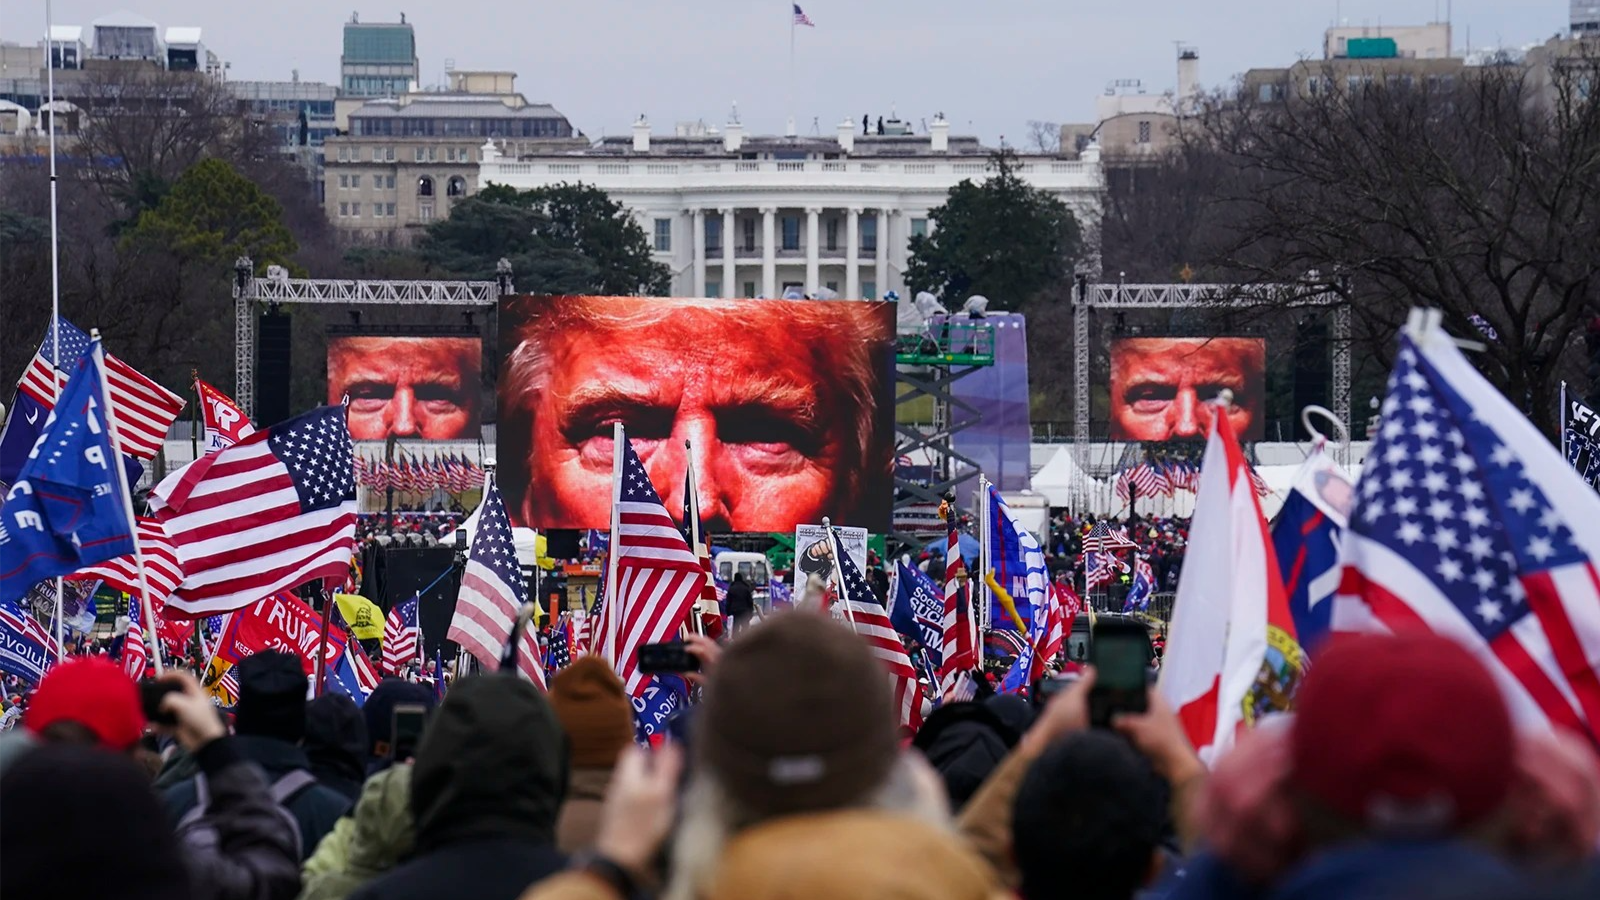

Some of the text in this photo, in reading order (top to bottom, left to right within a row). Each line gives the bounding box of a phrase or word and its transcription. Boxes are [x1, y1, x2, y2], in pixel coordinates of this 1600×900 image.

[34, 582, 59, 601] TRUM
[254, 596, 336, 660] TRUMP
[235, 640, 255, 657] KEEP
